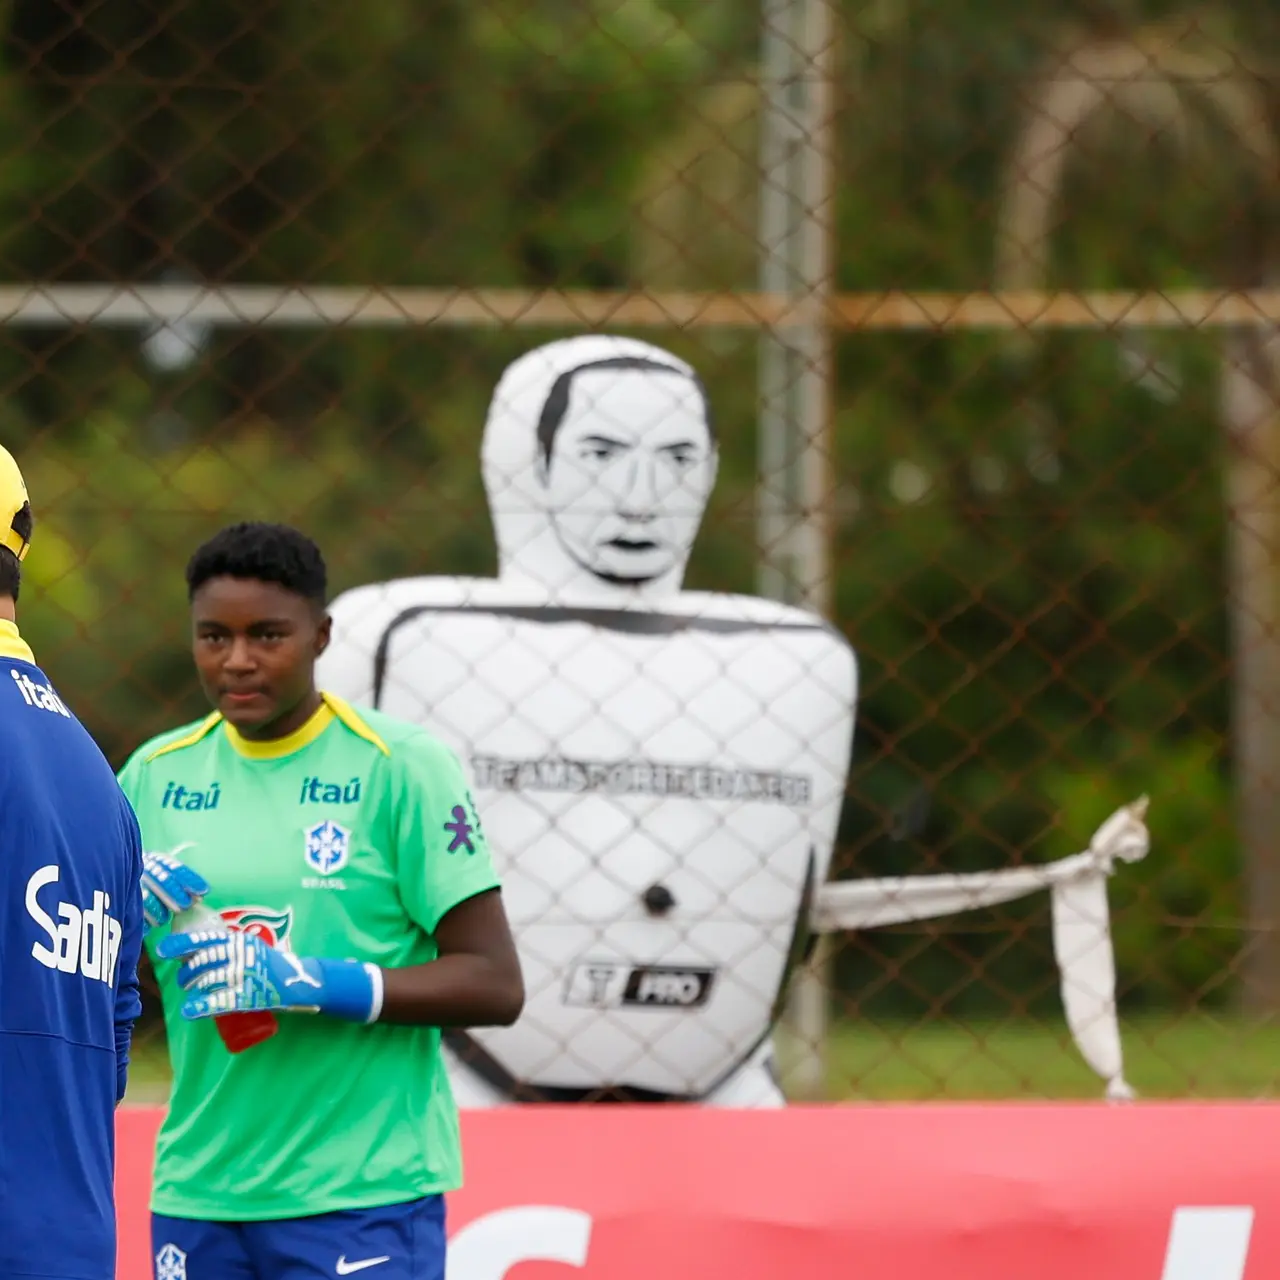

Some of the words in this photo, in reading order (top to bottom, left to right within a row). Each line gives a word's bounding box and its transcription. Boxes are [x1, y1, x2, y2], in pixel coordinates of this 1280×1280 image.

[10, 668, 71, 719] itaú
[161, 780, 222, 811] itaú
[300, 776, 362, 806] itaú
